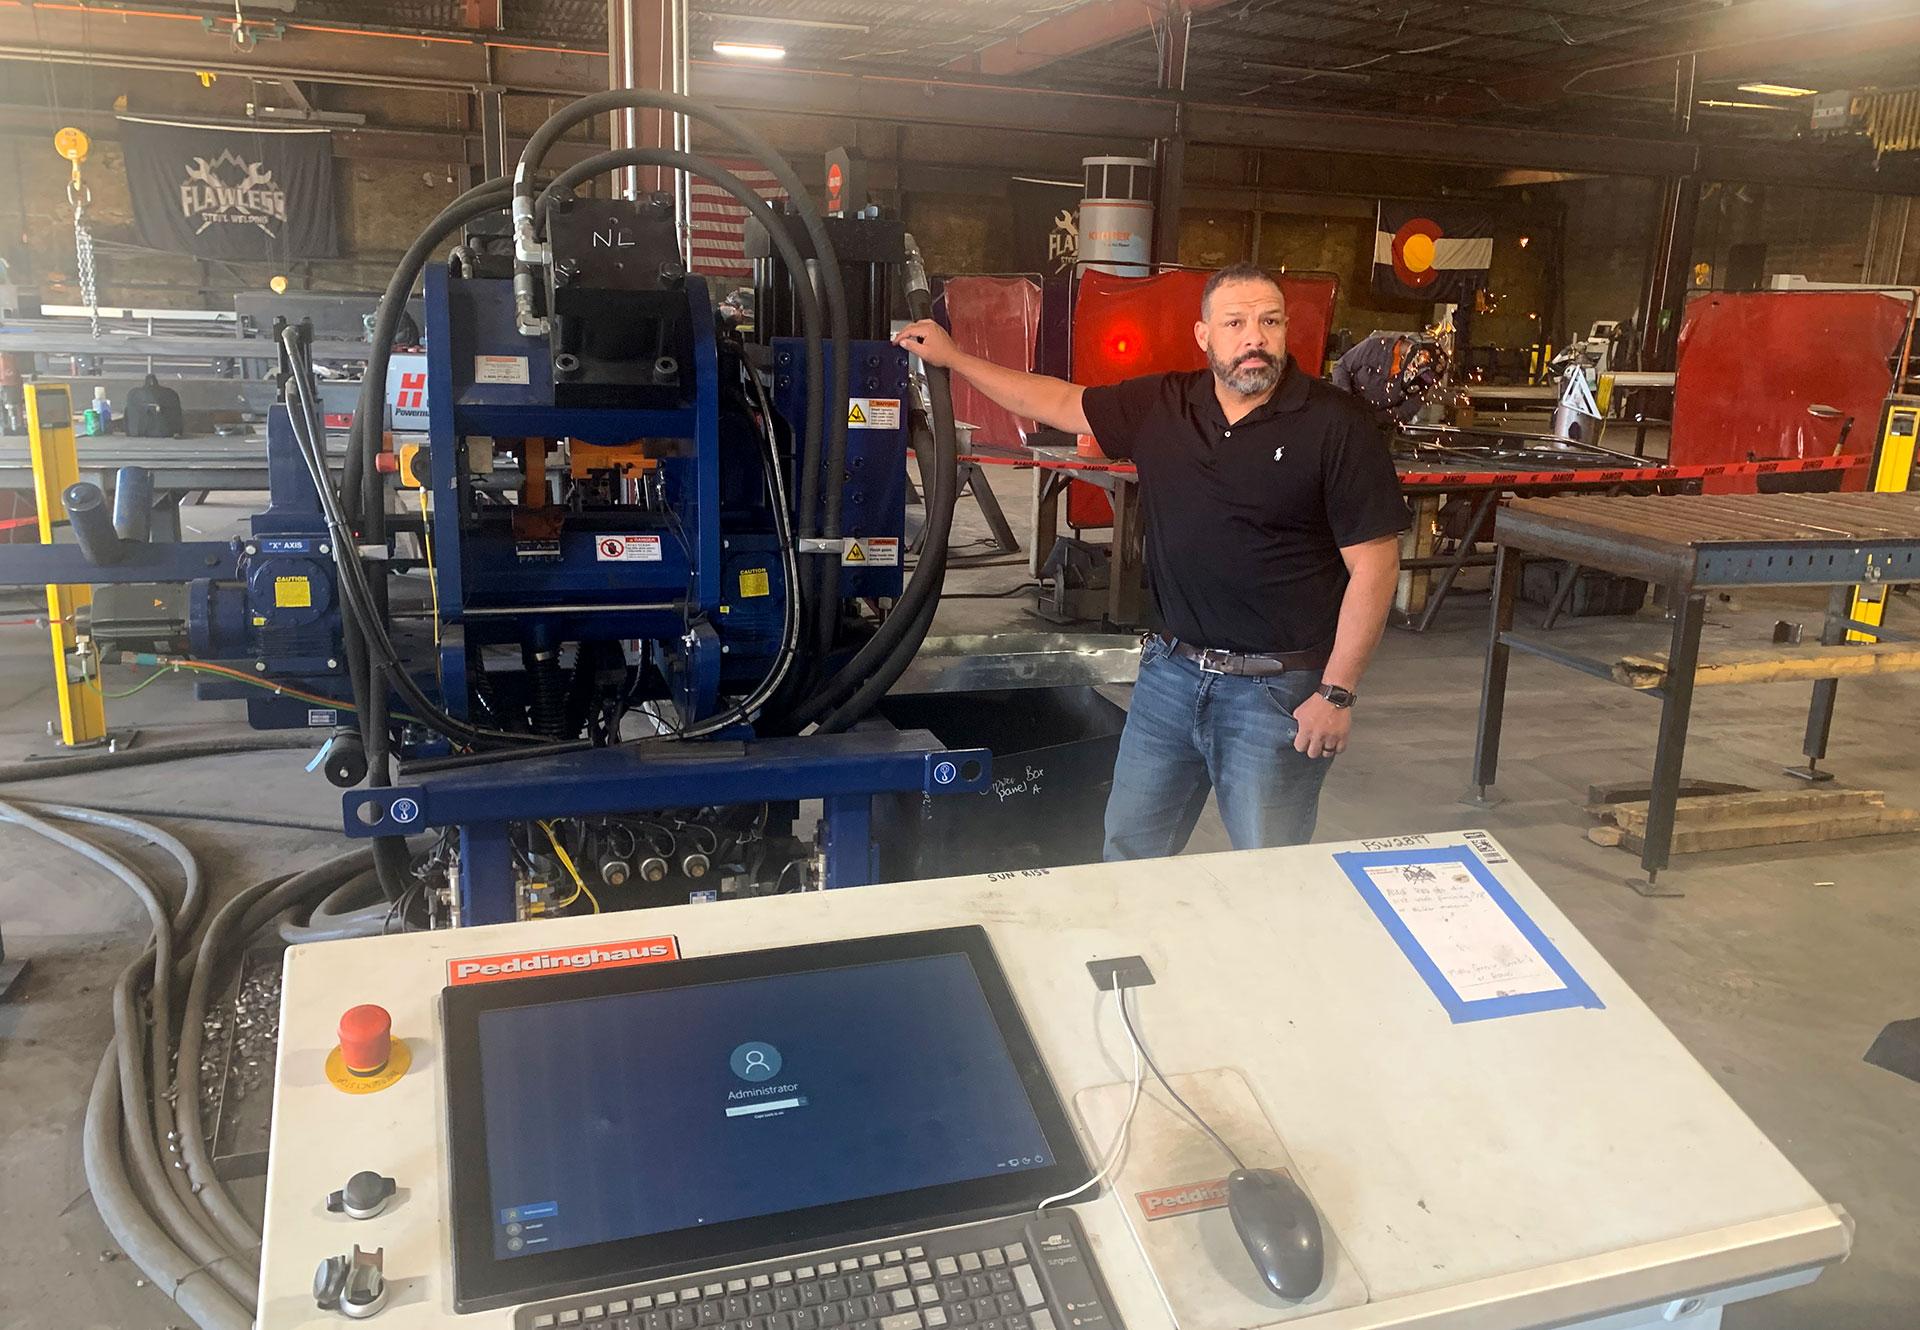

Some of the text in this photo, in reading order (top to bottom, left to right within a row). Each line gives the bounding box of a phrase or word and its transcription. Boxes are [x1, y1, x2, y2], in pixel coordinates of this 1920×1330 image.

[181, 185, 287, 222] FLAWLESS
[202, 213, 228, 222] STEEL
[988, 871, 1015, 882] SUN
[457, 945, 668, 979] Peddinghaus
[728, 1084, 798, 1100] Administrator
[1047, 1256, 1078, 1266] sungwoo
